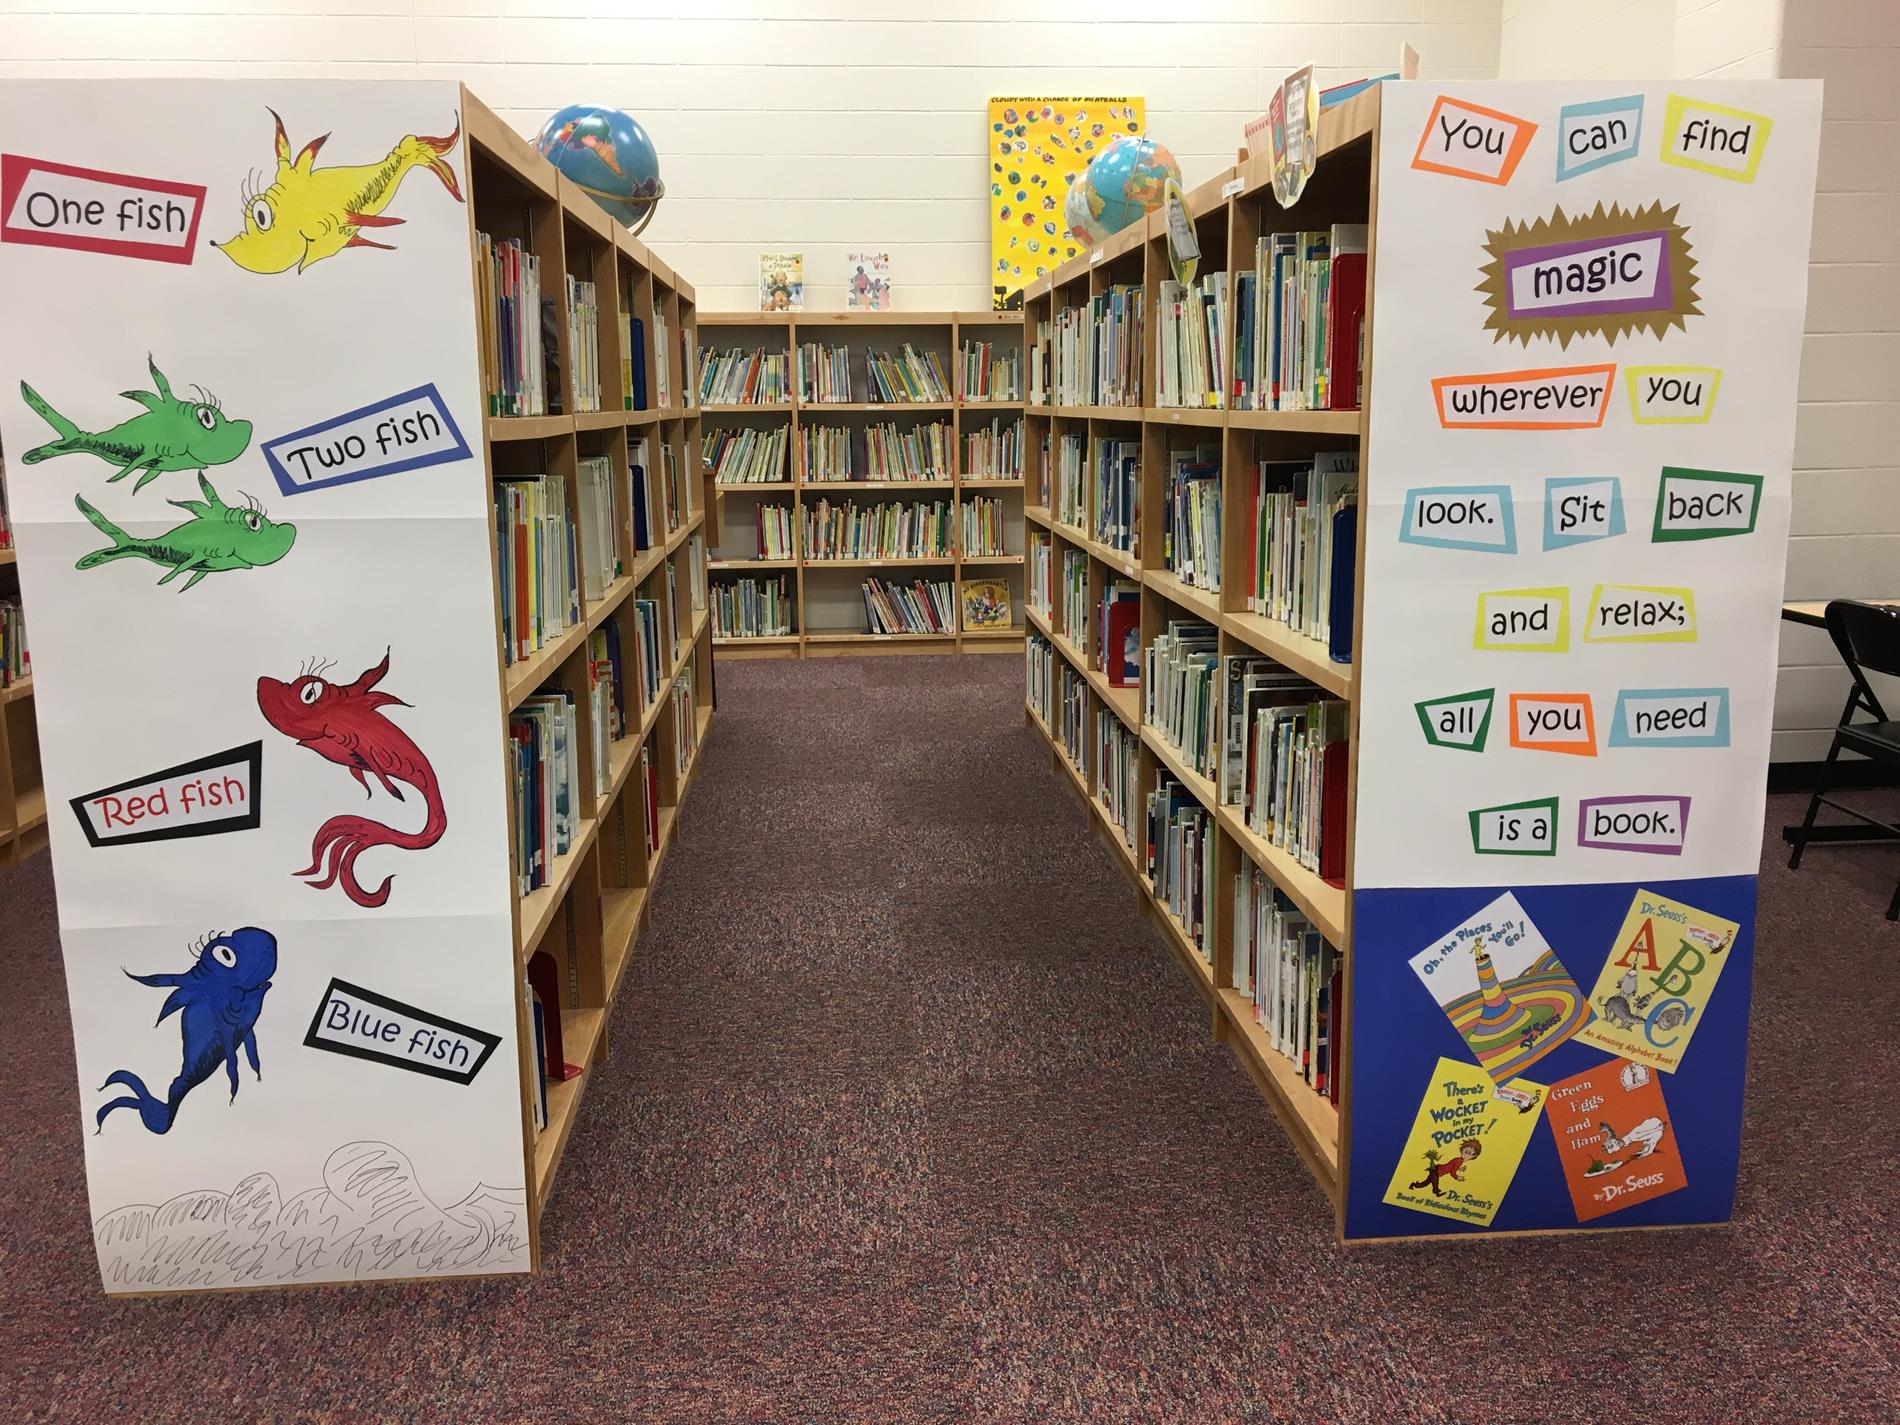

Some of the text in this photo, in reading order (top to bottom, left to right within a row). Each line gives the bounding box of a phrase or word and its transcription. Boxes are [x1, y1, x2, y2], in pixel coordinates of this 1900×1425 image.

[1440, 114, 1751, 156] You can find
[26, 192, 186, 233] One fish
[1533, 249, 1643, 299] magic
[1452, 376, 1702, 415] wherever you
[287, 409, 442, 481] Two fish
[1418, 491, 1744, 532] look. Sit back
[1491, 599, 1686, 636] and relax;
[1439, 701, 1708, 737] all you need
[94, 775, 245, 829] Red fish
[1498, 809, 1676, 842] is a book.
[1640, 901, 1688, 925] Dr. Seuss's
[1440, 940, 1458, 956] the
[1455, 922, 1493, 942] Places
[1488, 920, 1515, 944] You'll
[1504, 920, 1526, 947] Go!
[325, 999, 470, 1069] Blue fish
[1533, 1013, 1562, 1037] Seuss
[1584, 1029, 1595, 1038] An
[1595, 1034, 1625, 1050] Amazing
[1625, 1043, 1656, 1059] Alphabet
[1443, 1081, 1485, 1098] There's
[1551, 1080, 1593, 1101] Green
[1570, 1094, 1605, 1113] Eggs
[1429, 1100, 1489, 1125] WOCKET
[1452, 1117, 1474, 1127] in my
[1566, 1117, 1592, 1135] and
[1431, 1118, 1499, 1149] POCKET!
[1571, 1134, 1601, 1150] Ham
[1396, 1192, 1417, 1202] Book
[1446, 1189, 1494, 1211] Dr. Seuss's
[1603, 1185, 1627, 1201] Dr.
[1626, 1172, 1664, 1192] Seuss
